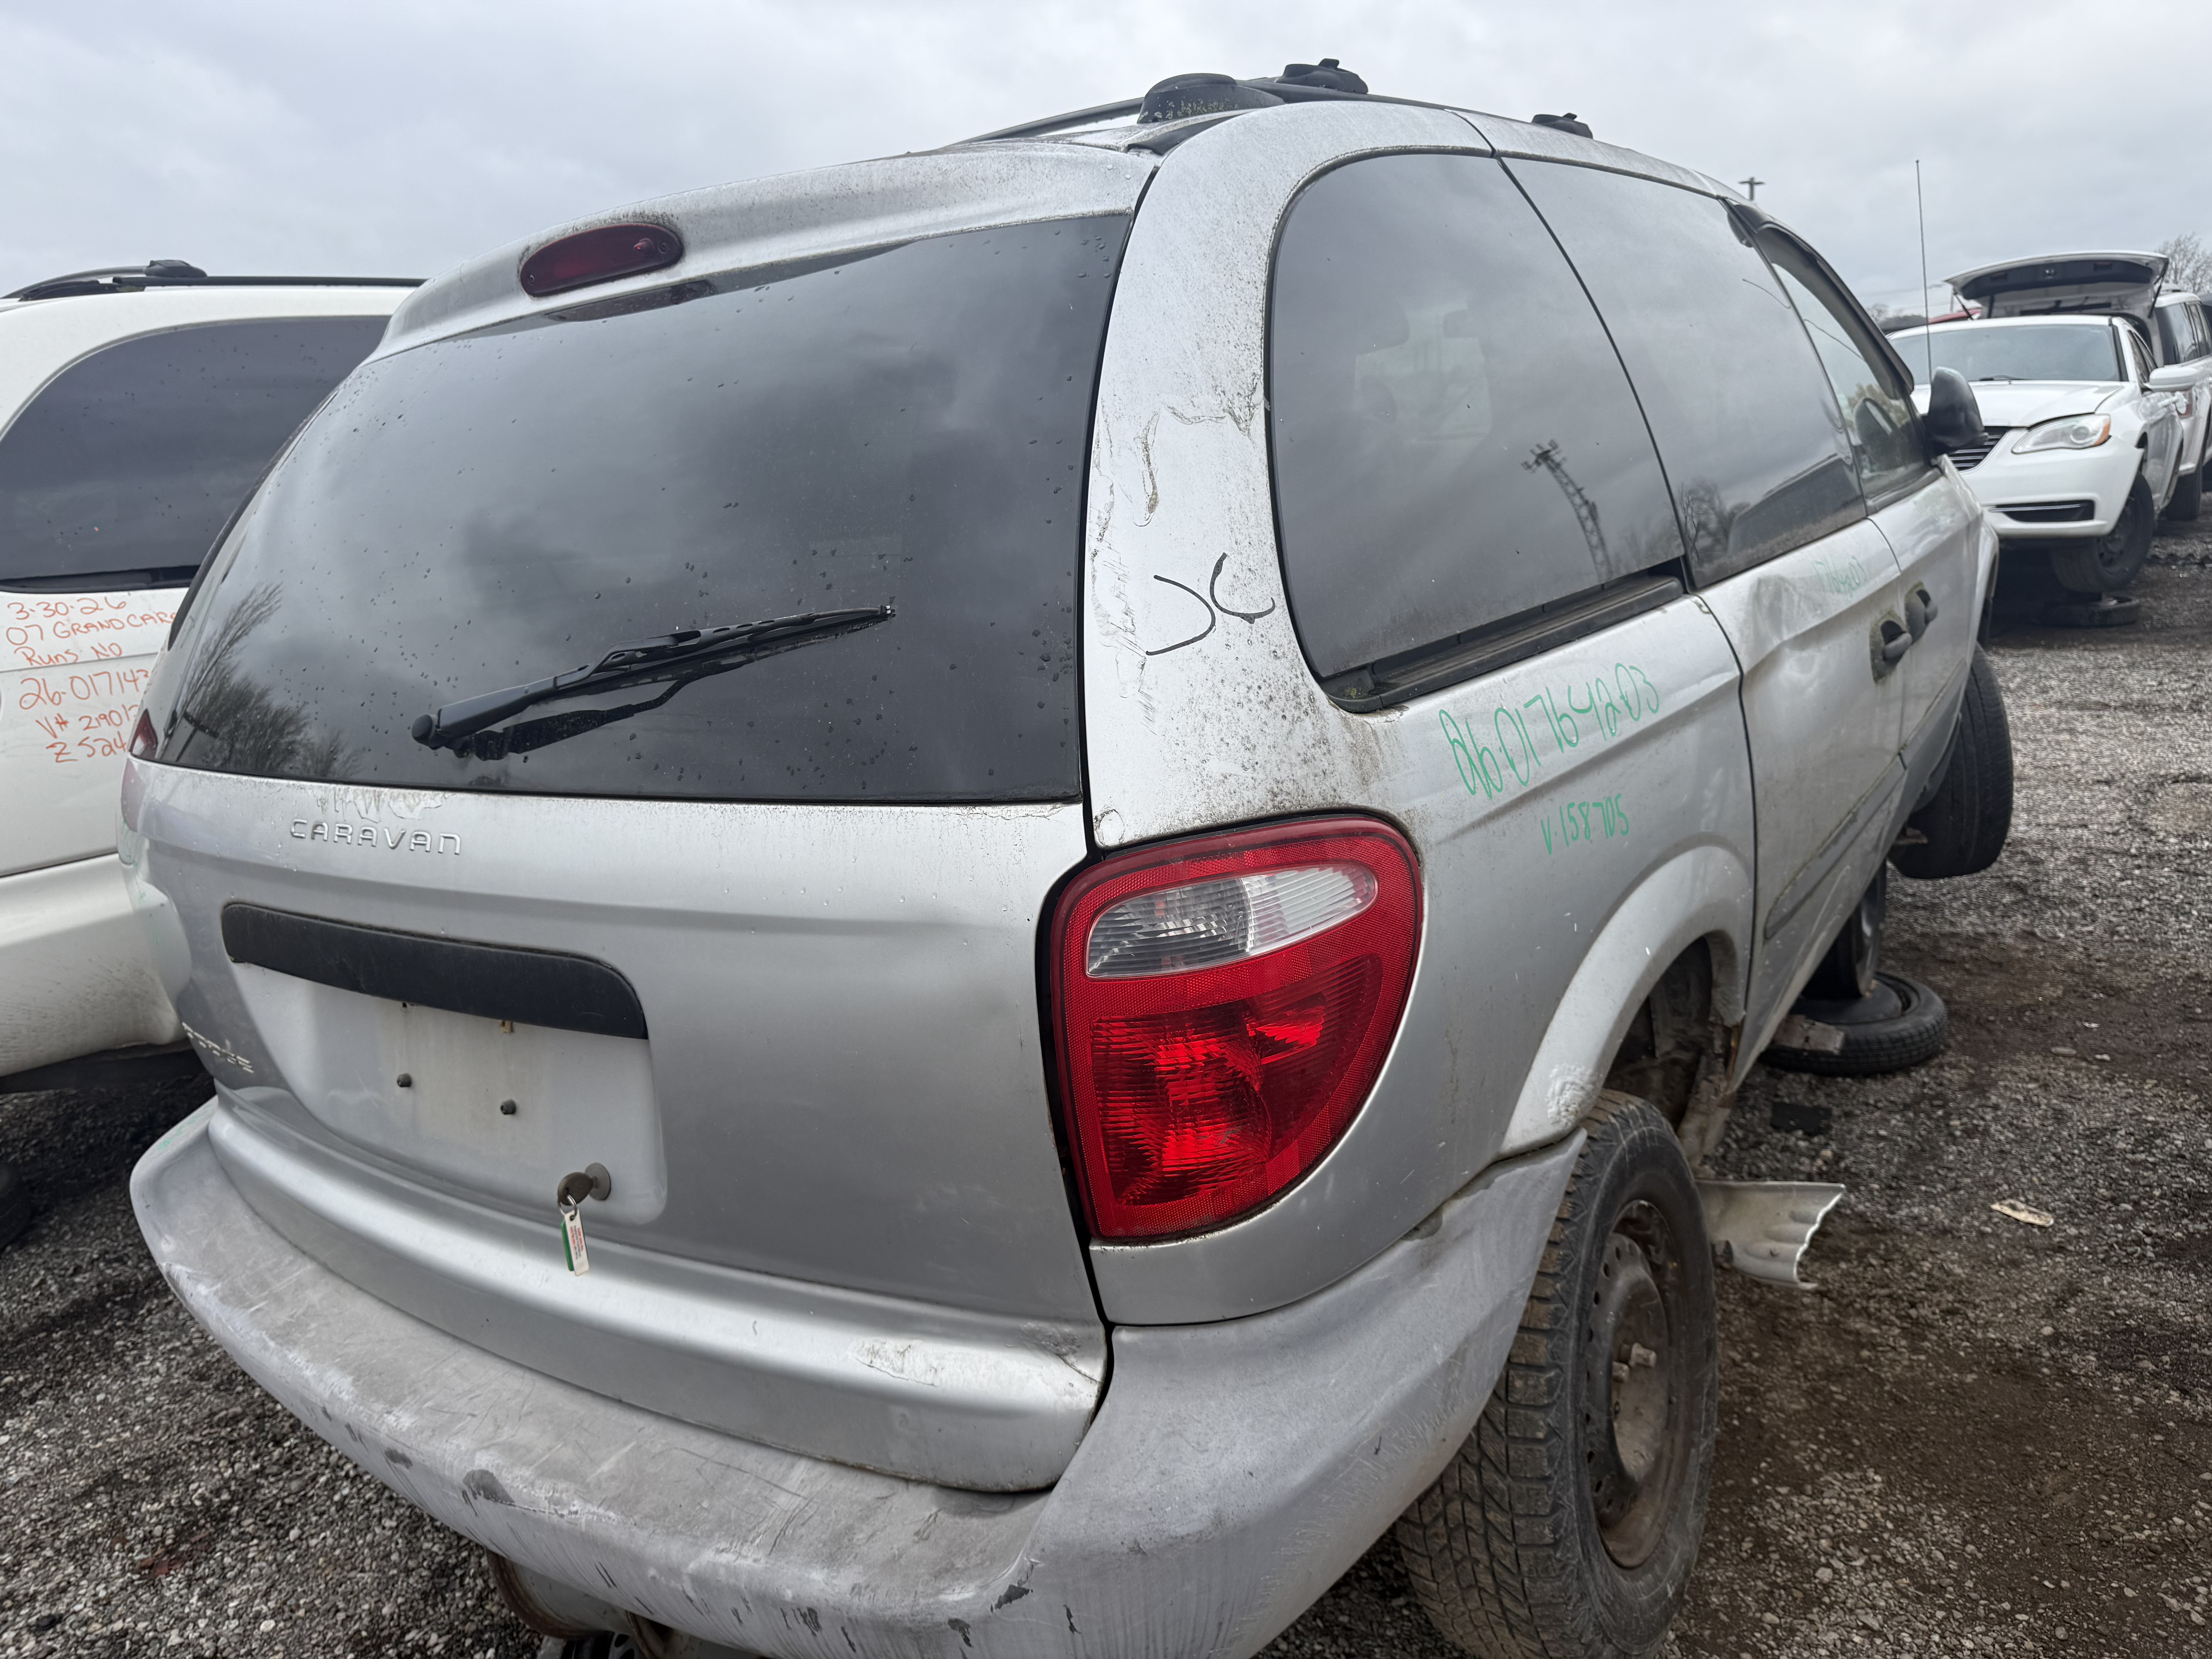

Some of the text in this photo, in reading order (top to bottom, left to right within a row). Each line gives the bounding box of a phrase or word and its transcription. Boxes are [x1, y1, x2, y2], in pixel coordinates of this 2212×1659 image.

[6, 624, 43, 646] 07
[91, 642, 122, 659] NO
[291, 819, 460, 855] CARAVAN
